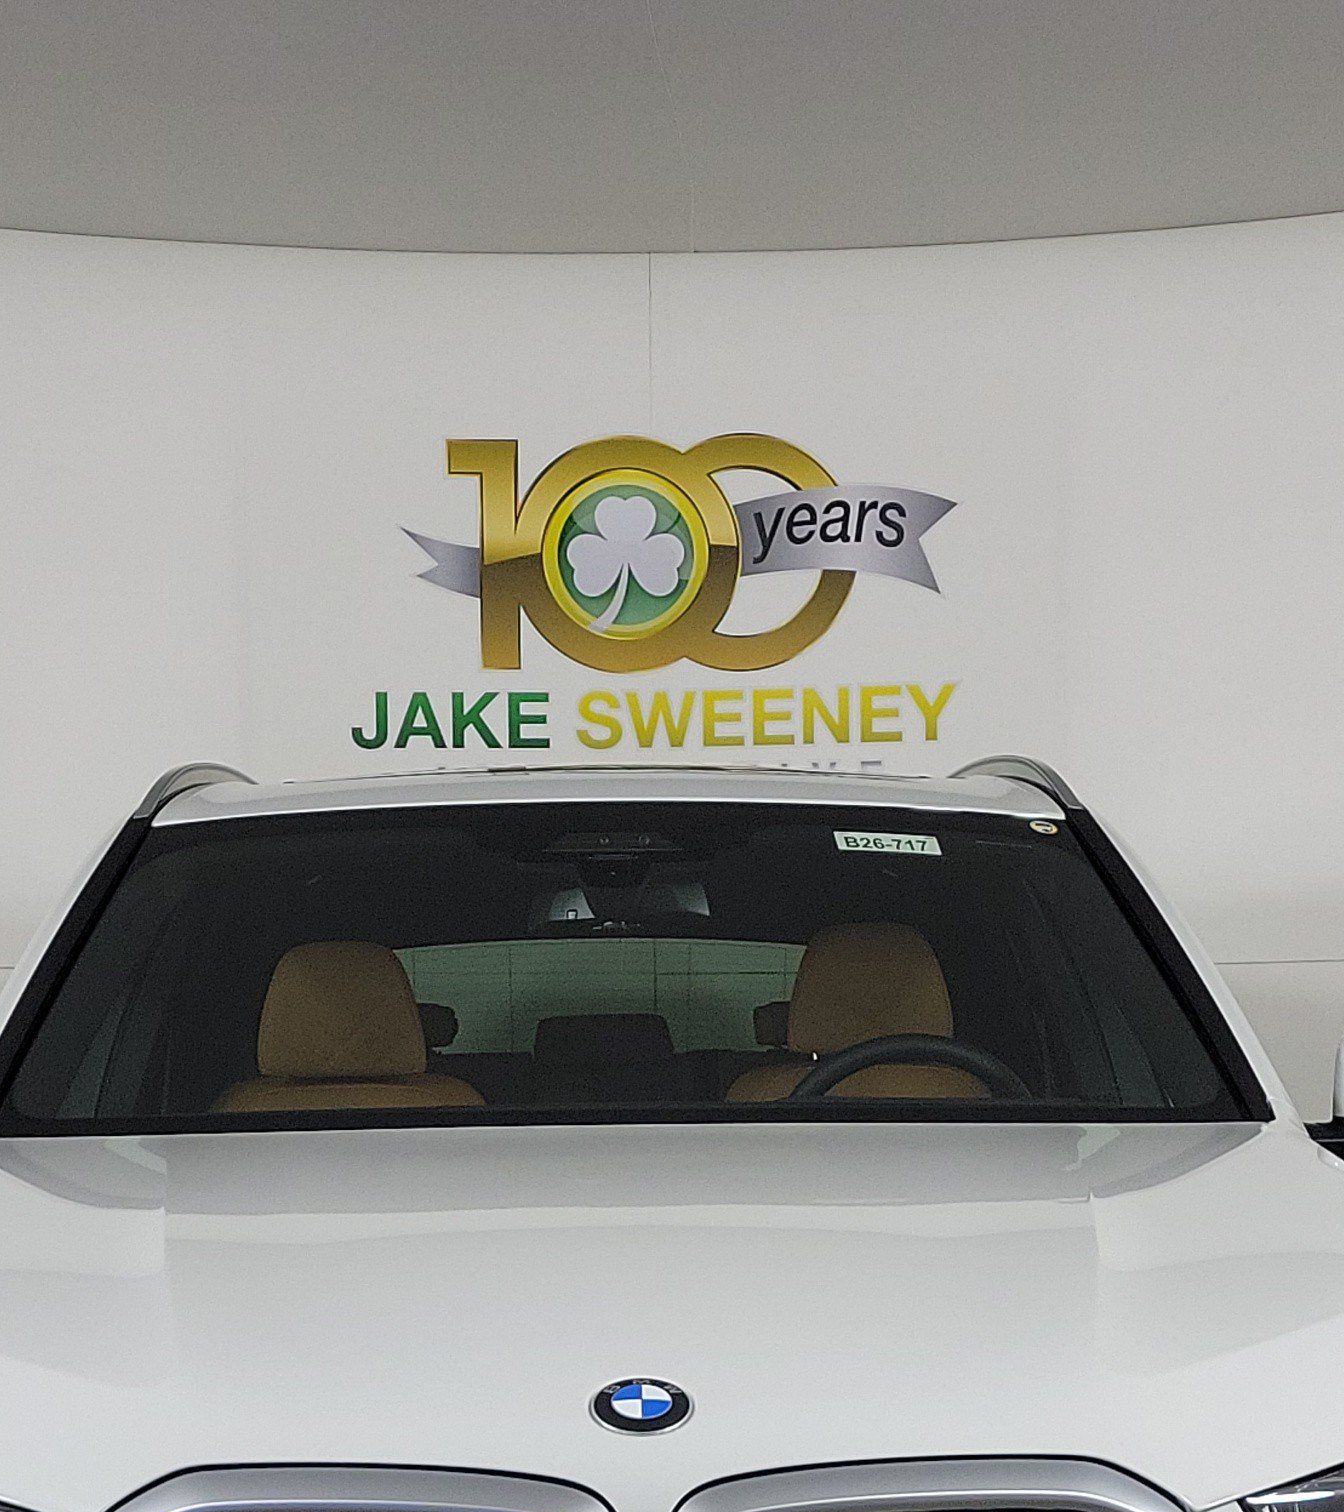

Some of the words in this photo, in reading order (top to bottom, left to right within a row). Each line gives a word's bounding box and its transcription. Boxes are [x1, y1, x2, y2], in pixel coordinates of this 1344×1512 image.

[445, 432, 856, 673] 100
[752, 498, 907, 564] years
[351, 690, 551, 749] JAKE
[575, 683, 958, 749] SWEENEY
[843, 835, 928, 852] B26-717
